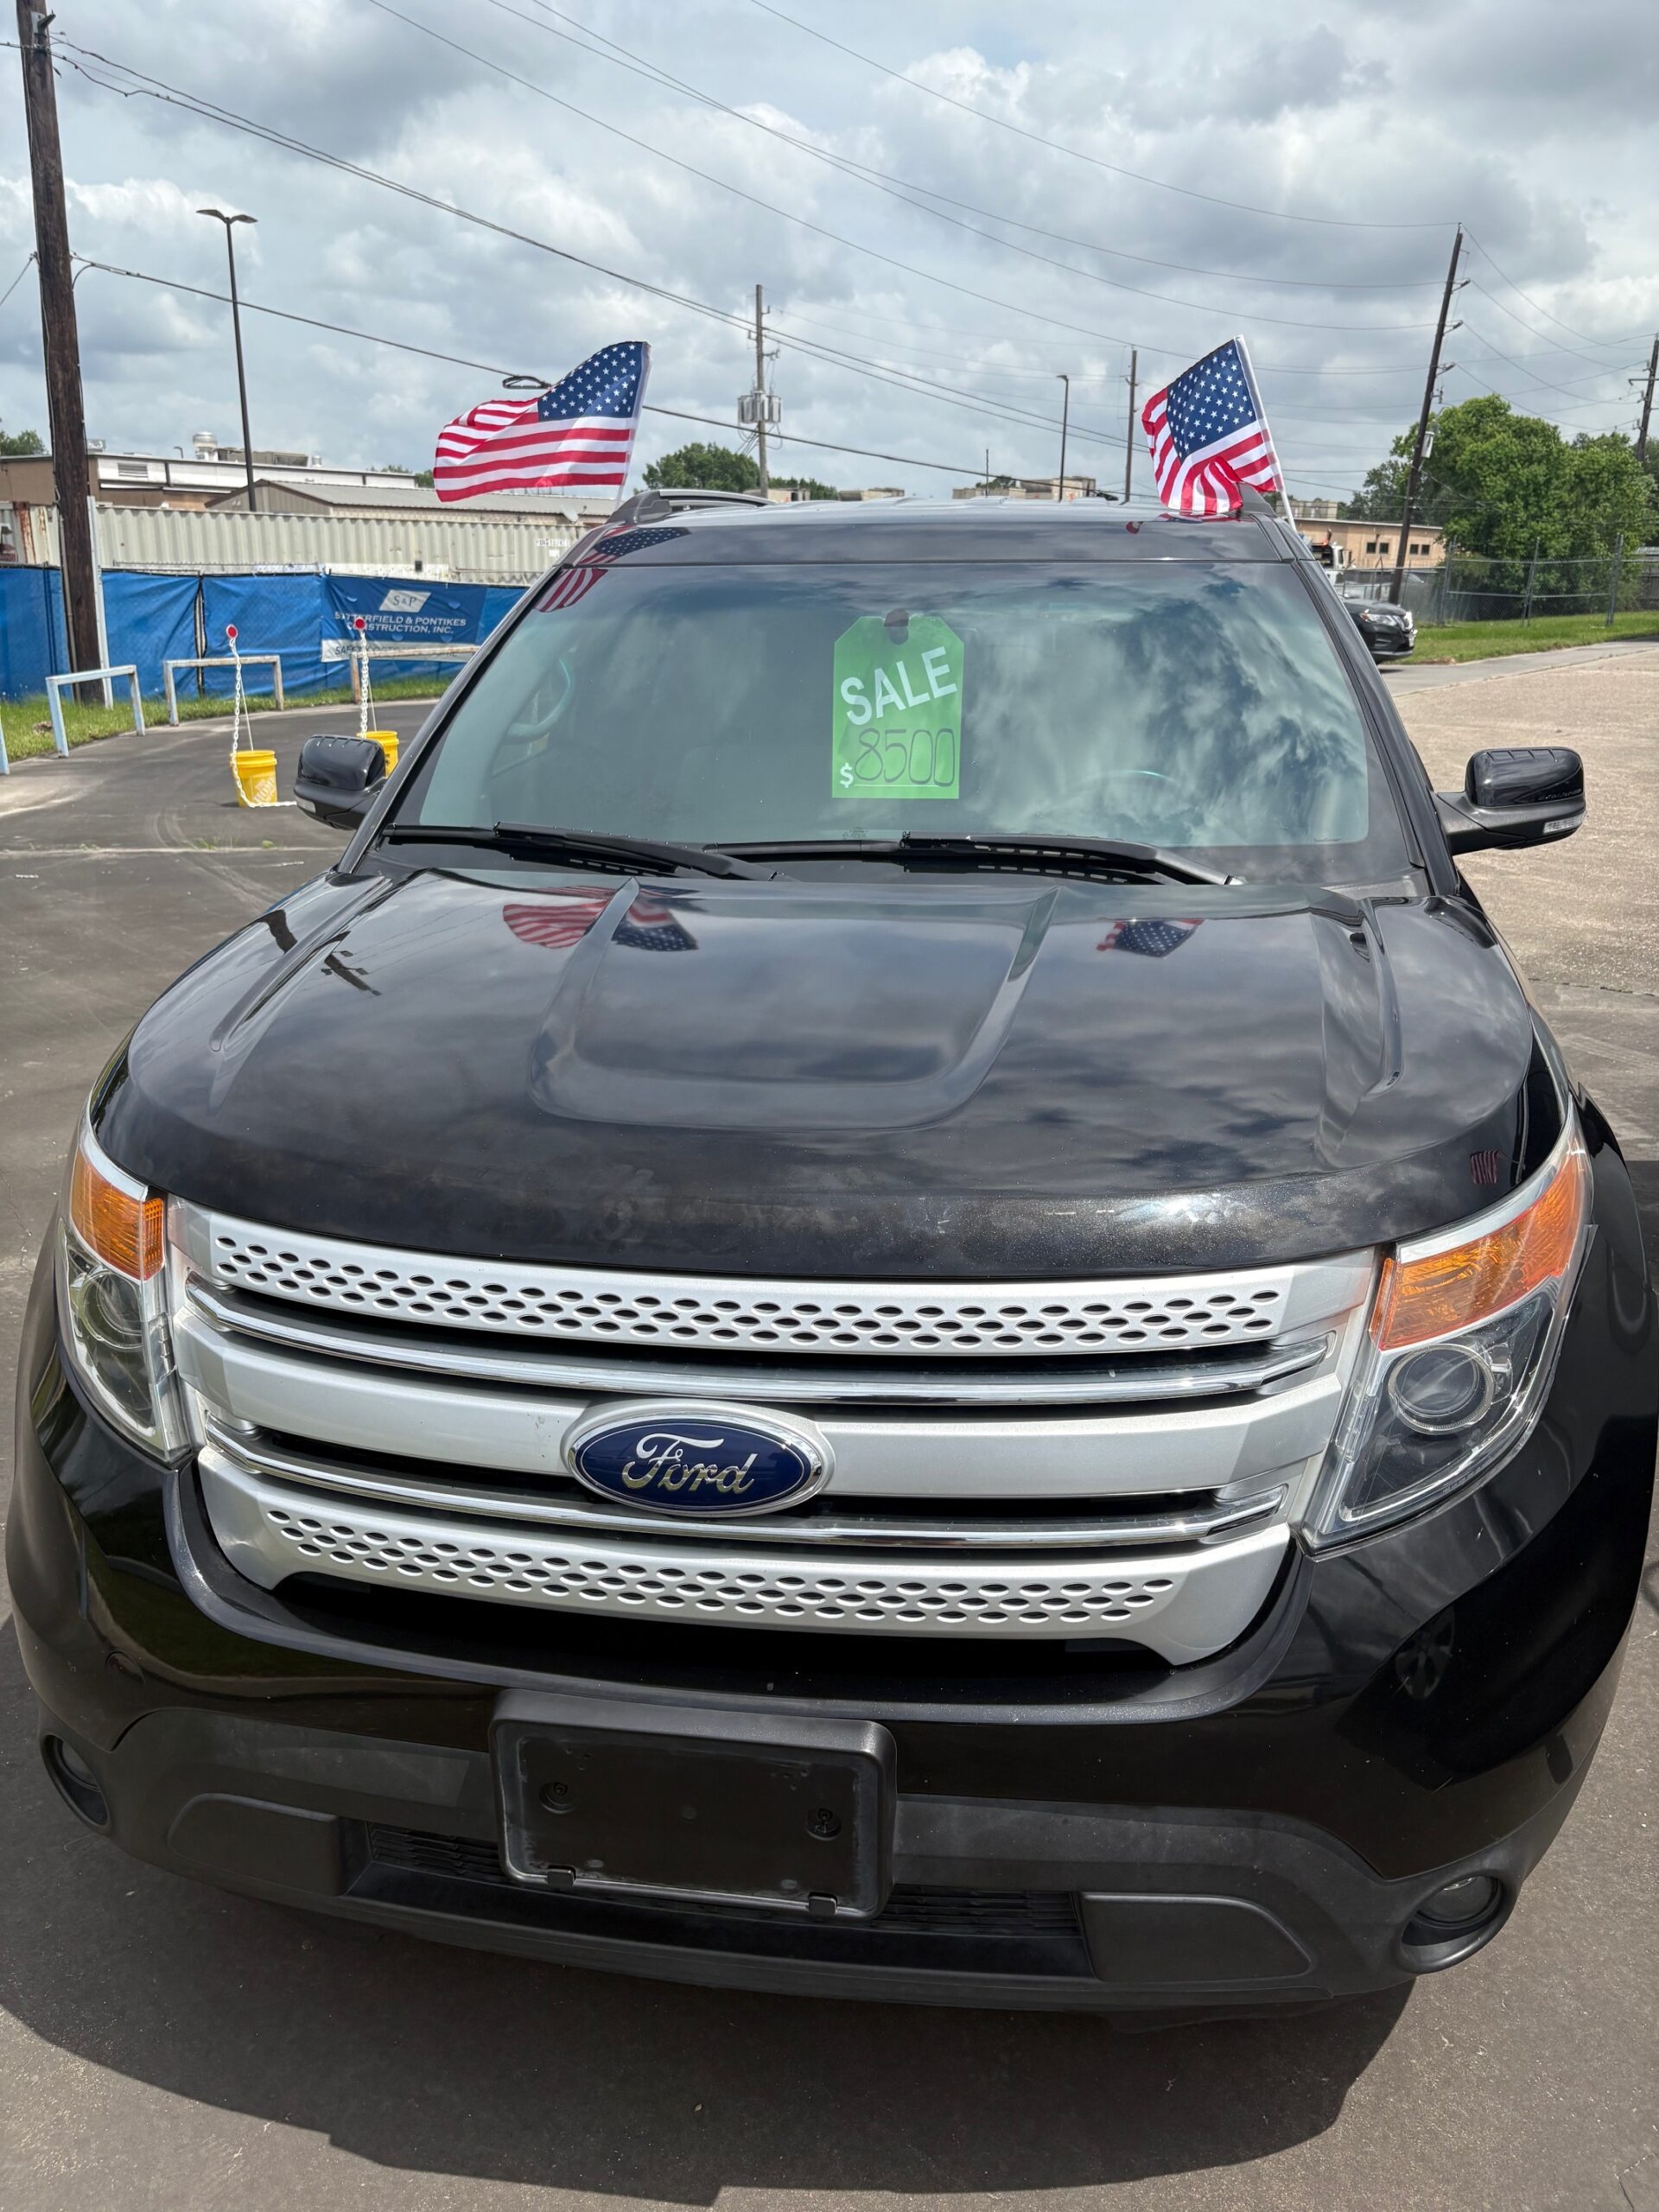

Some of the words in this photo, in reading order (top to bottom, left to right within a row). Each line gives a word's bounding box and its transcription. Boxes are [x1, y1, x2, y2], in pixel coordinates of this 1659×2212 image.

[334, 611, 404, 624] SATTRFIELD
[415, 616, 467, 626] PONTIKES
[433, 626, 454, 634] INC.
[840, 645, 958, 726] SALE
[621, 1433, 758, 1495] Ford
